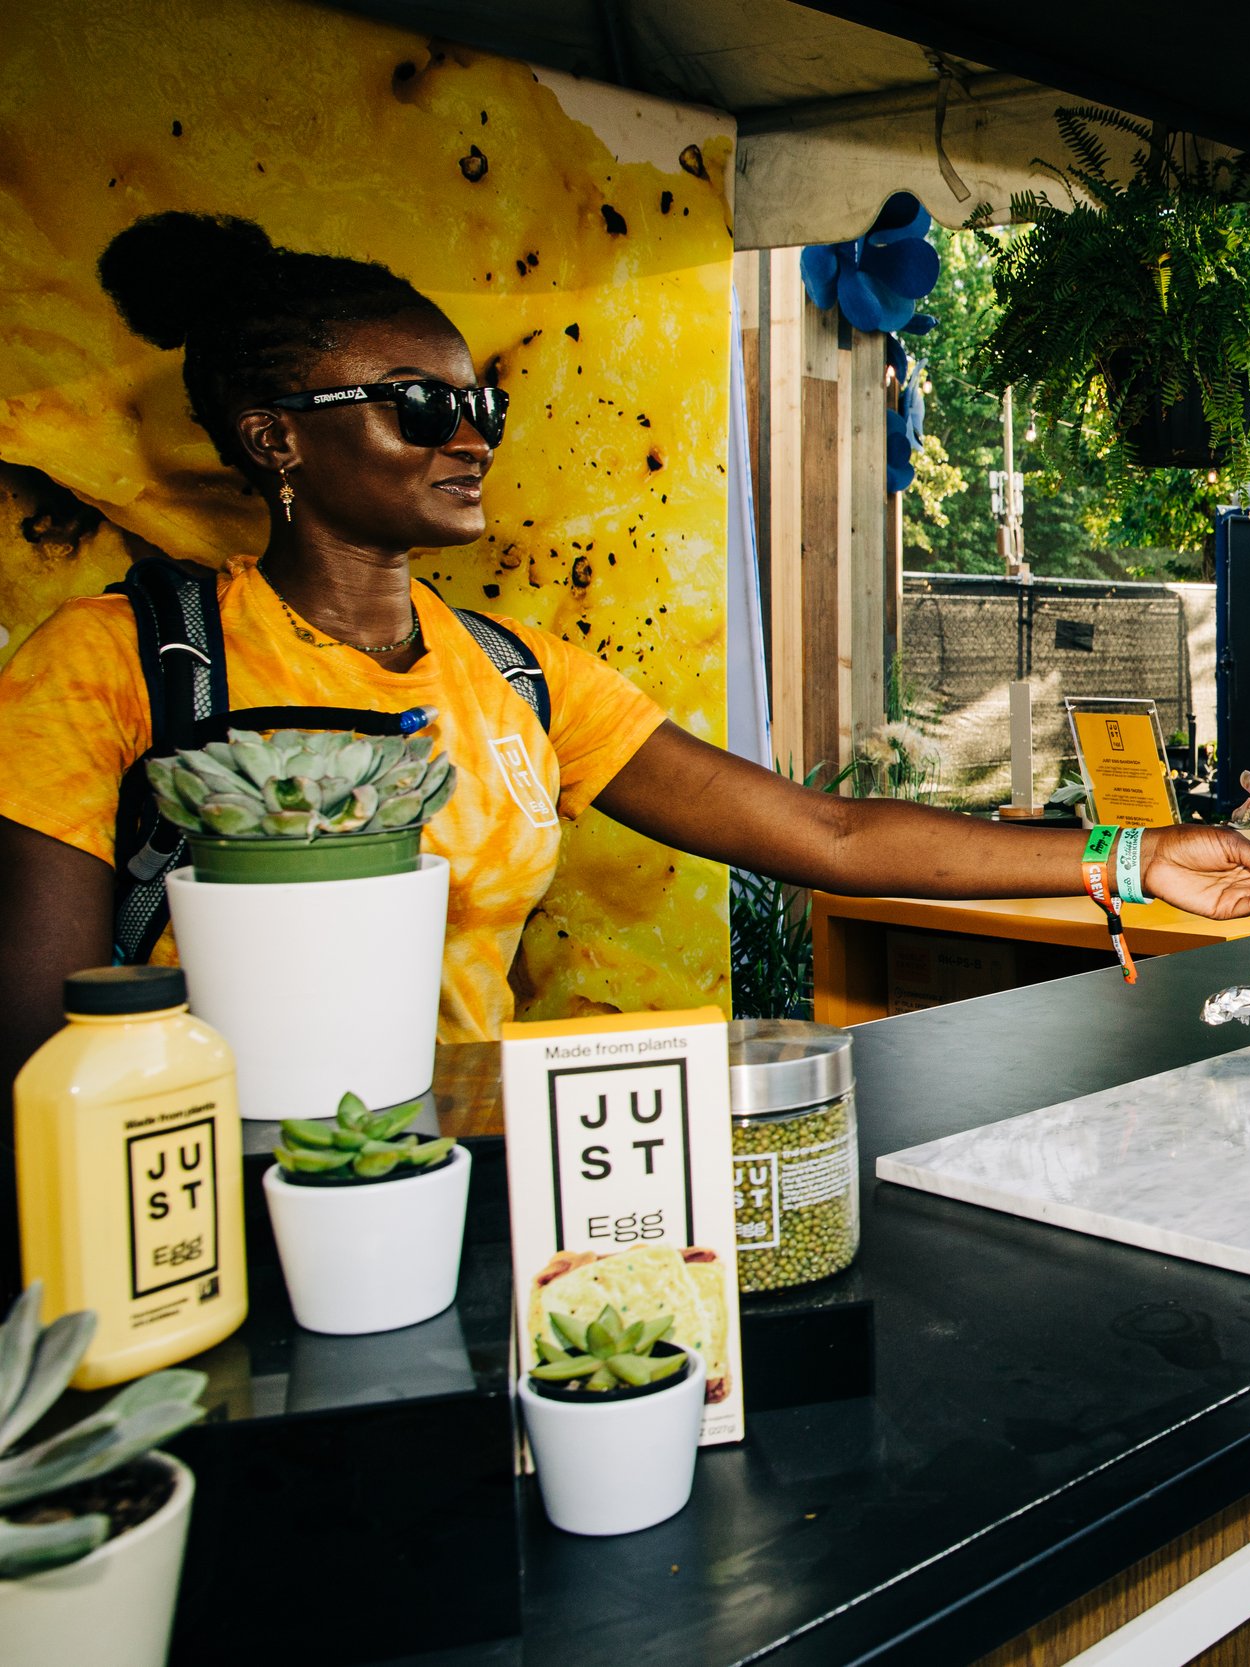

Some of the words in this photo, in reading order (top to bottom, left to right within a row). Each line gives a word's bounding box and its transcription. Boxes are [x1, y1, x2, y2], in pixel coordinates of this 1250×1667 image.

[1089, 864, 1105, 901] CREW
[545, 1046, 592, 1060] Made
[595, 1041, 634, 1057] from
[637, 1036, 688, 1054] plants
[588, 1209, 665, 1243] Egg
[153, 1233, 203, 1267] Egg
